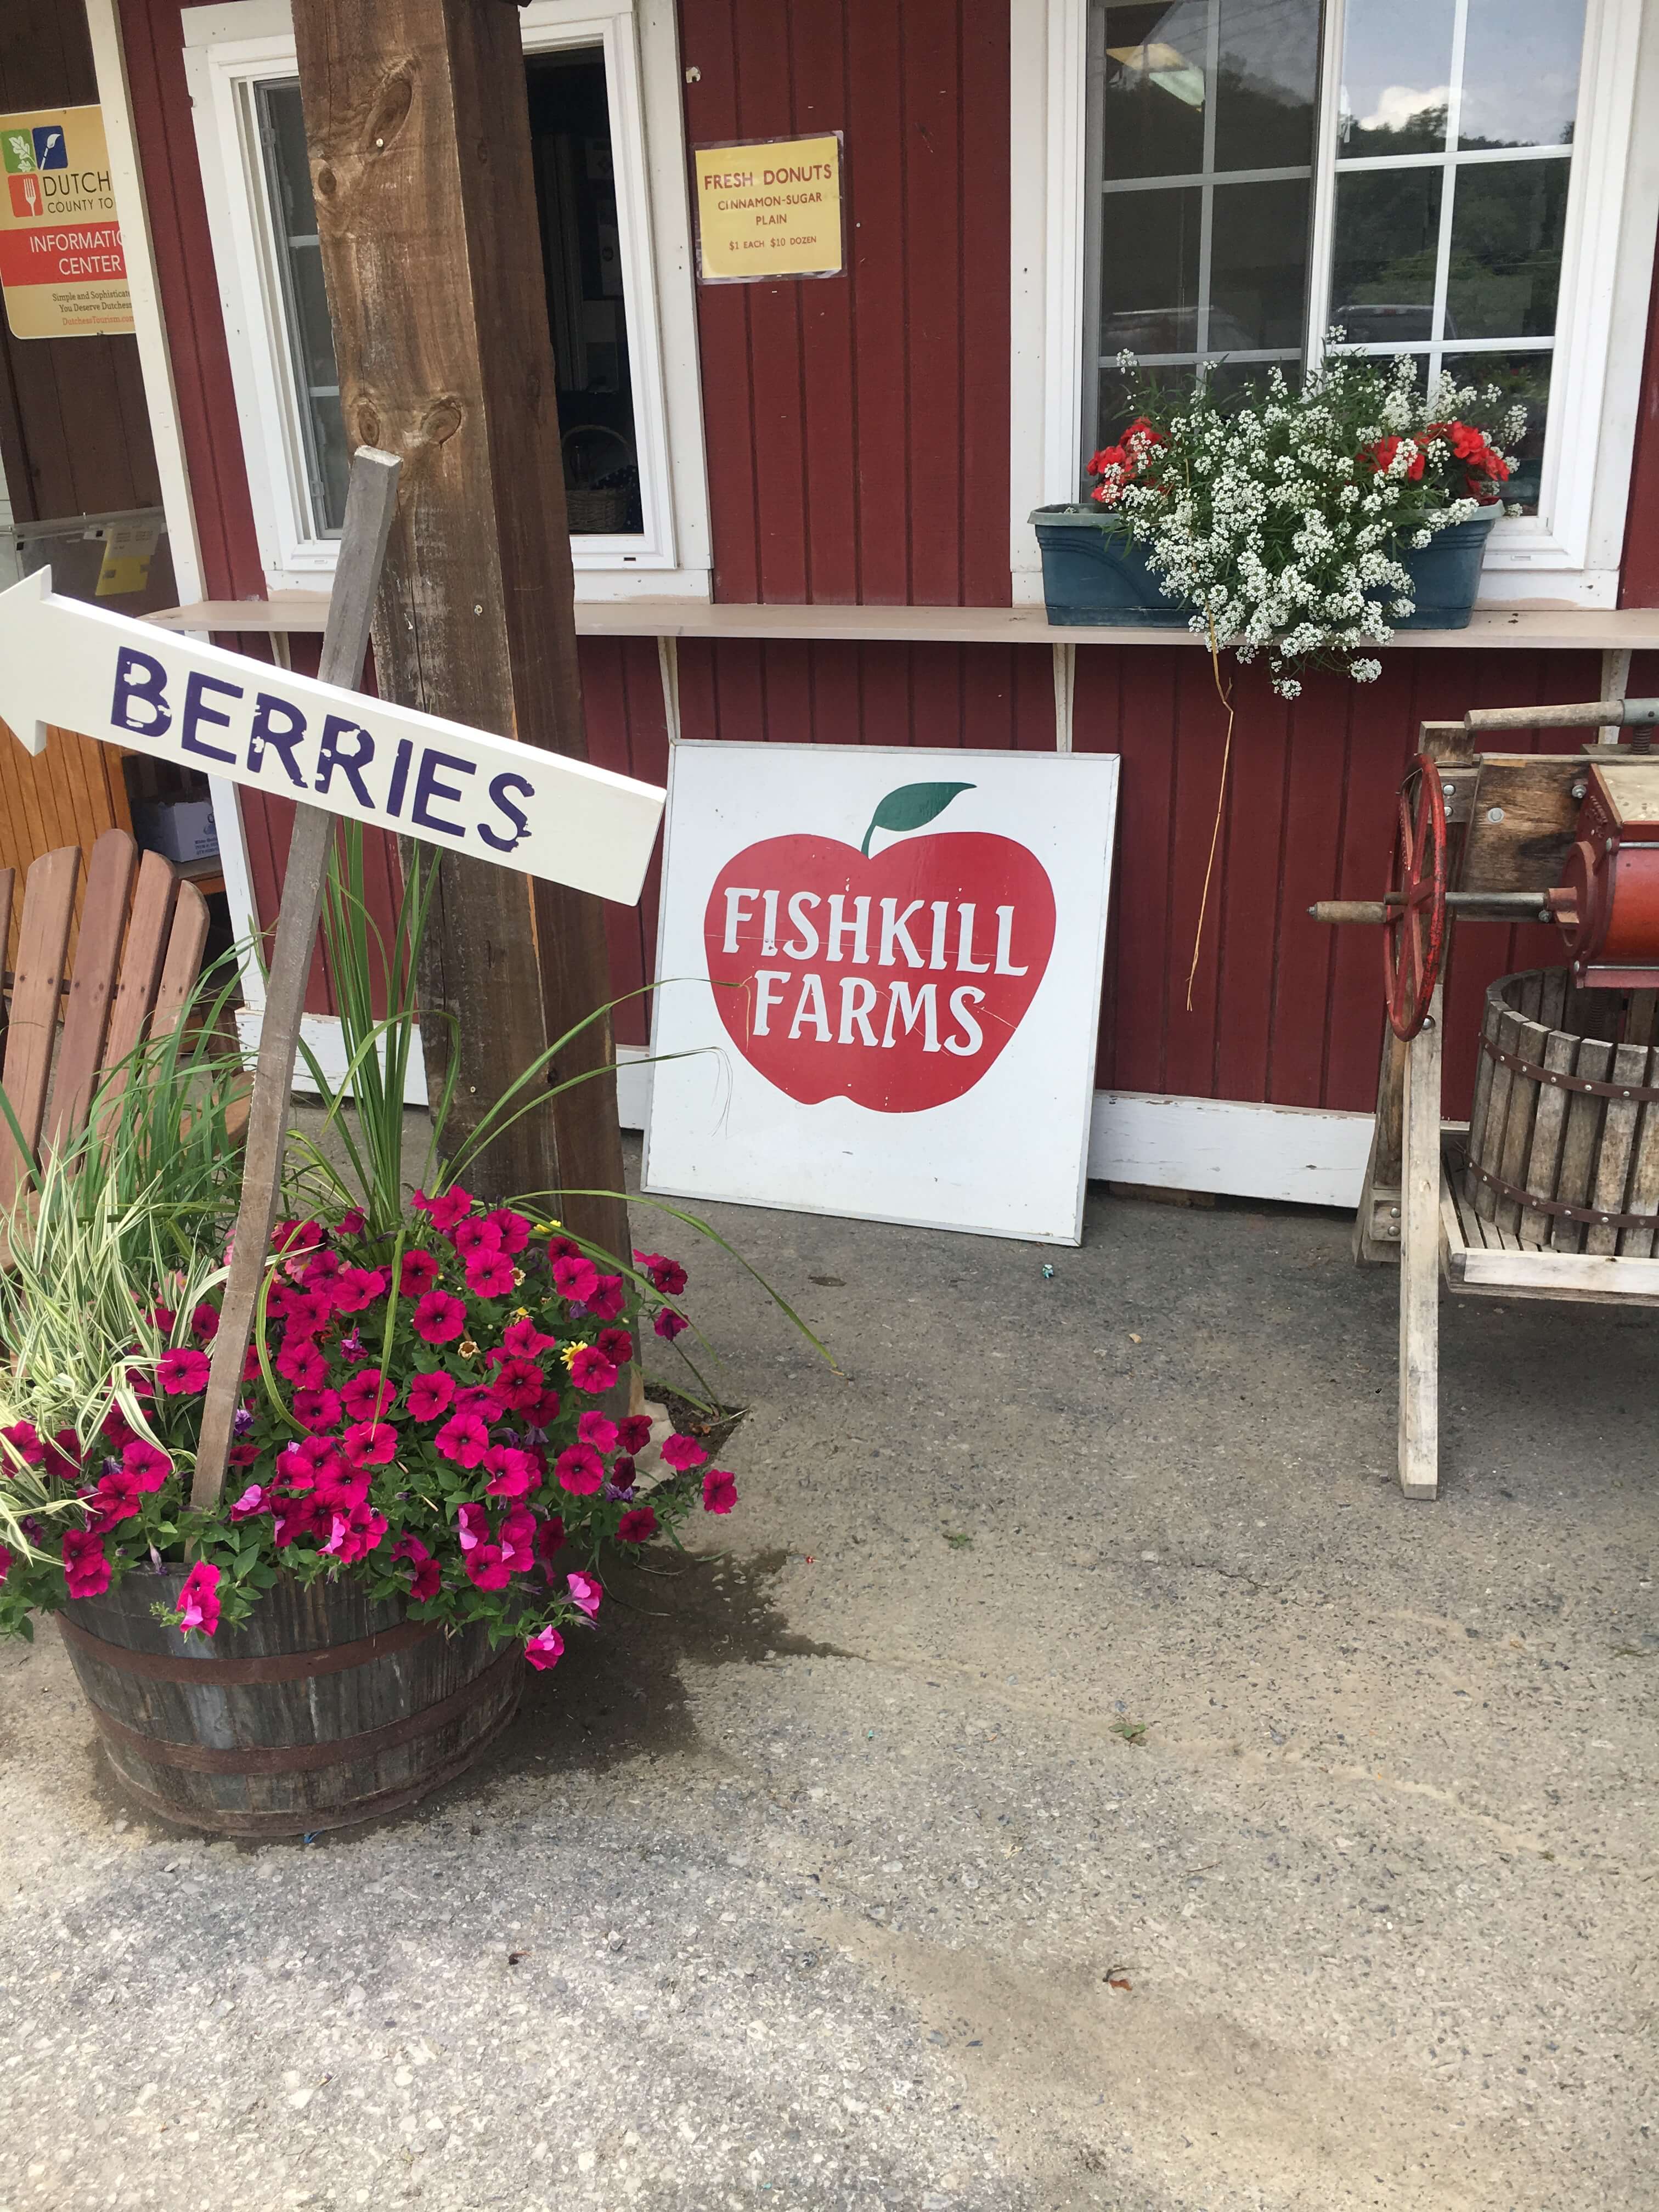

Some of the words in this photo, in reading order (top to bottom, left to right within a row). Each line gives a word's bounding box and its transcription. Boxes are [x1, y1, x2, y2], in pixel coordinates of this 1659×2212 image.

[704, 172, 753, 190] FRESH
[763, 164, 832, 185] DONUTS
[48, 199, 93, 214] COUNTY
[718, 192, 822, 211] CINNAMON-SUGAR
[756, 214, 787, 225] PLAIN
[729, 240, 739, 251] $1
[743, 240, 764, 249] EACH
[770, 237, 786, 248] $10
[790, 236, 817, 245] DOZEN
[59, 255, 122, 275] CENTER
[52, 292, 76, 302] Simple
[77, 291, 89, 300] and
[59, 304, 72, 312] You
[101, 301, 132, 310] Dutchess
[110, 646, 535, 853] BERRIES
[721, 887, 1029, 977] FISHKILL
[752, 969, 986, 1057] FARMS
